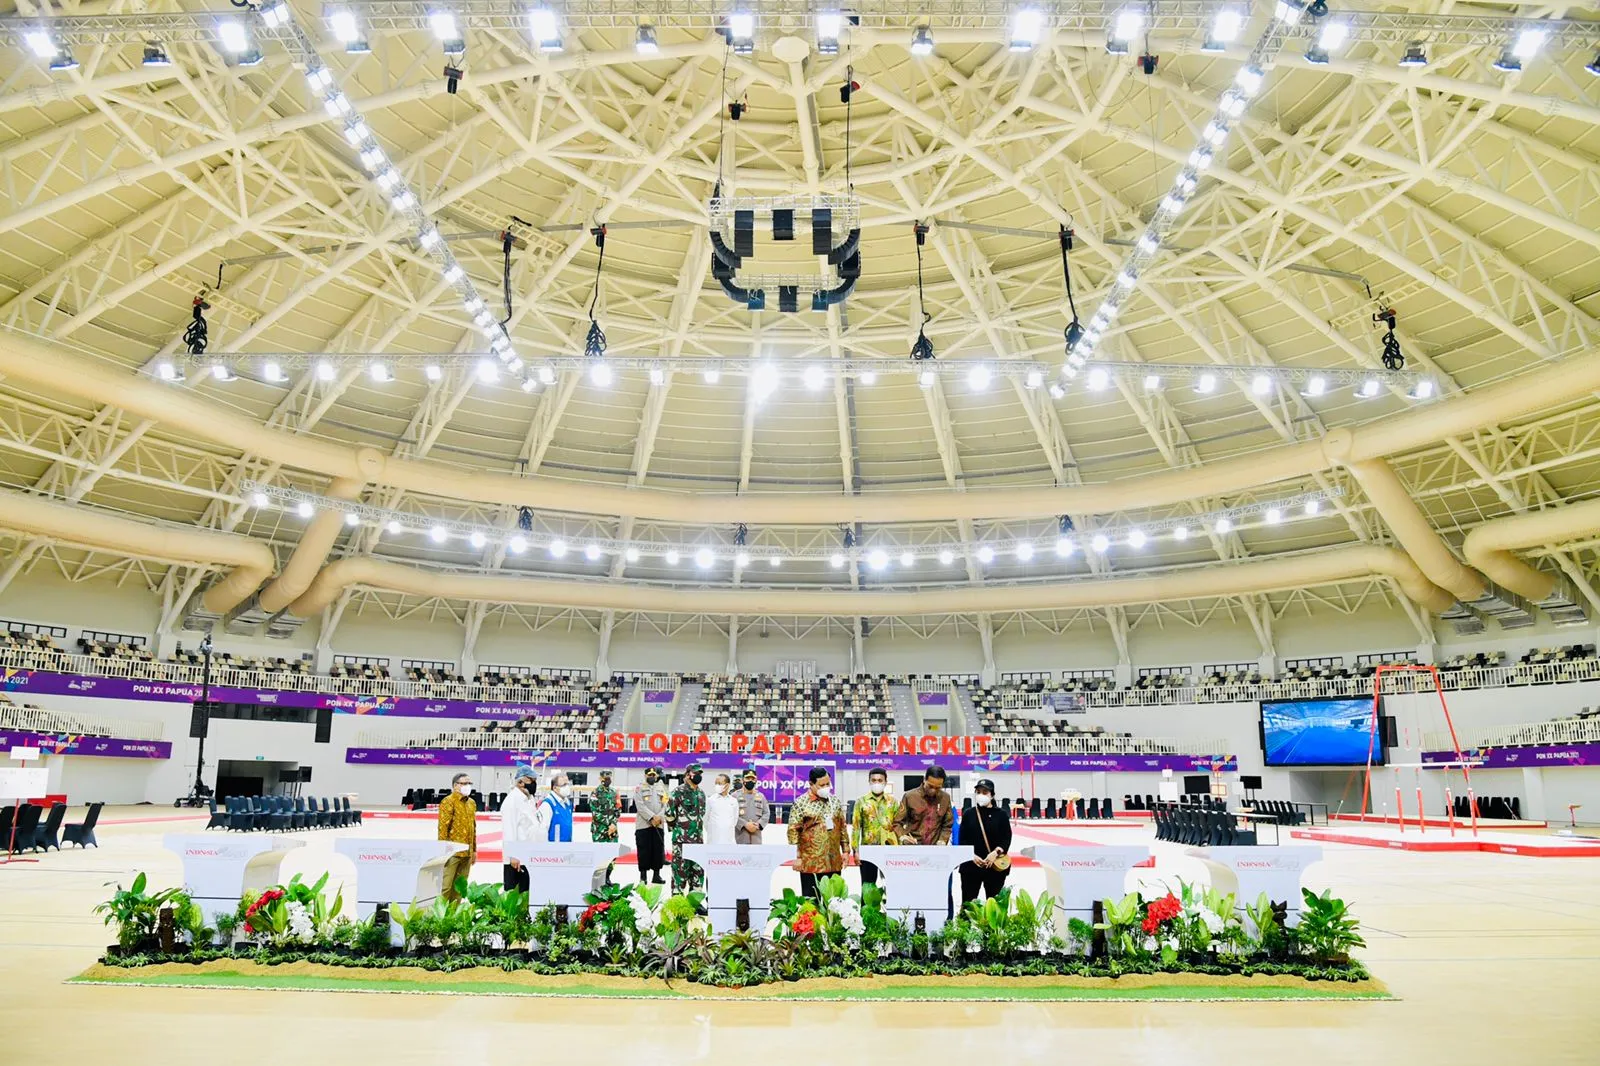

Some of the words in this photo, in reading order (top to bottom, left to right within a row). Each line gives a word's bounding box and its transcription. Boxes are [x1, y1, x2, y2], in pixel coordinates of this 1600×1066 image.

[10, 676, 28, 686] 2021
[133, 685, 151, 693] PON
[152, 686, 164, 694] XX
[165, 687, 193, 696] PAPUA
[194, 689, 210, 697] 201
[597, 732, 711, 754] ISTORA
[731, 734, 835, 754] PAPUA
[853, 735, 992, 755] BANGKIT
[755, 780, 777, 789] PON
[780, 780, 793, 789] XX
